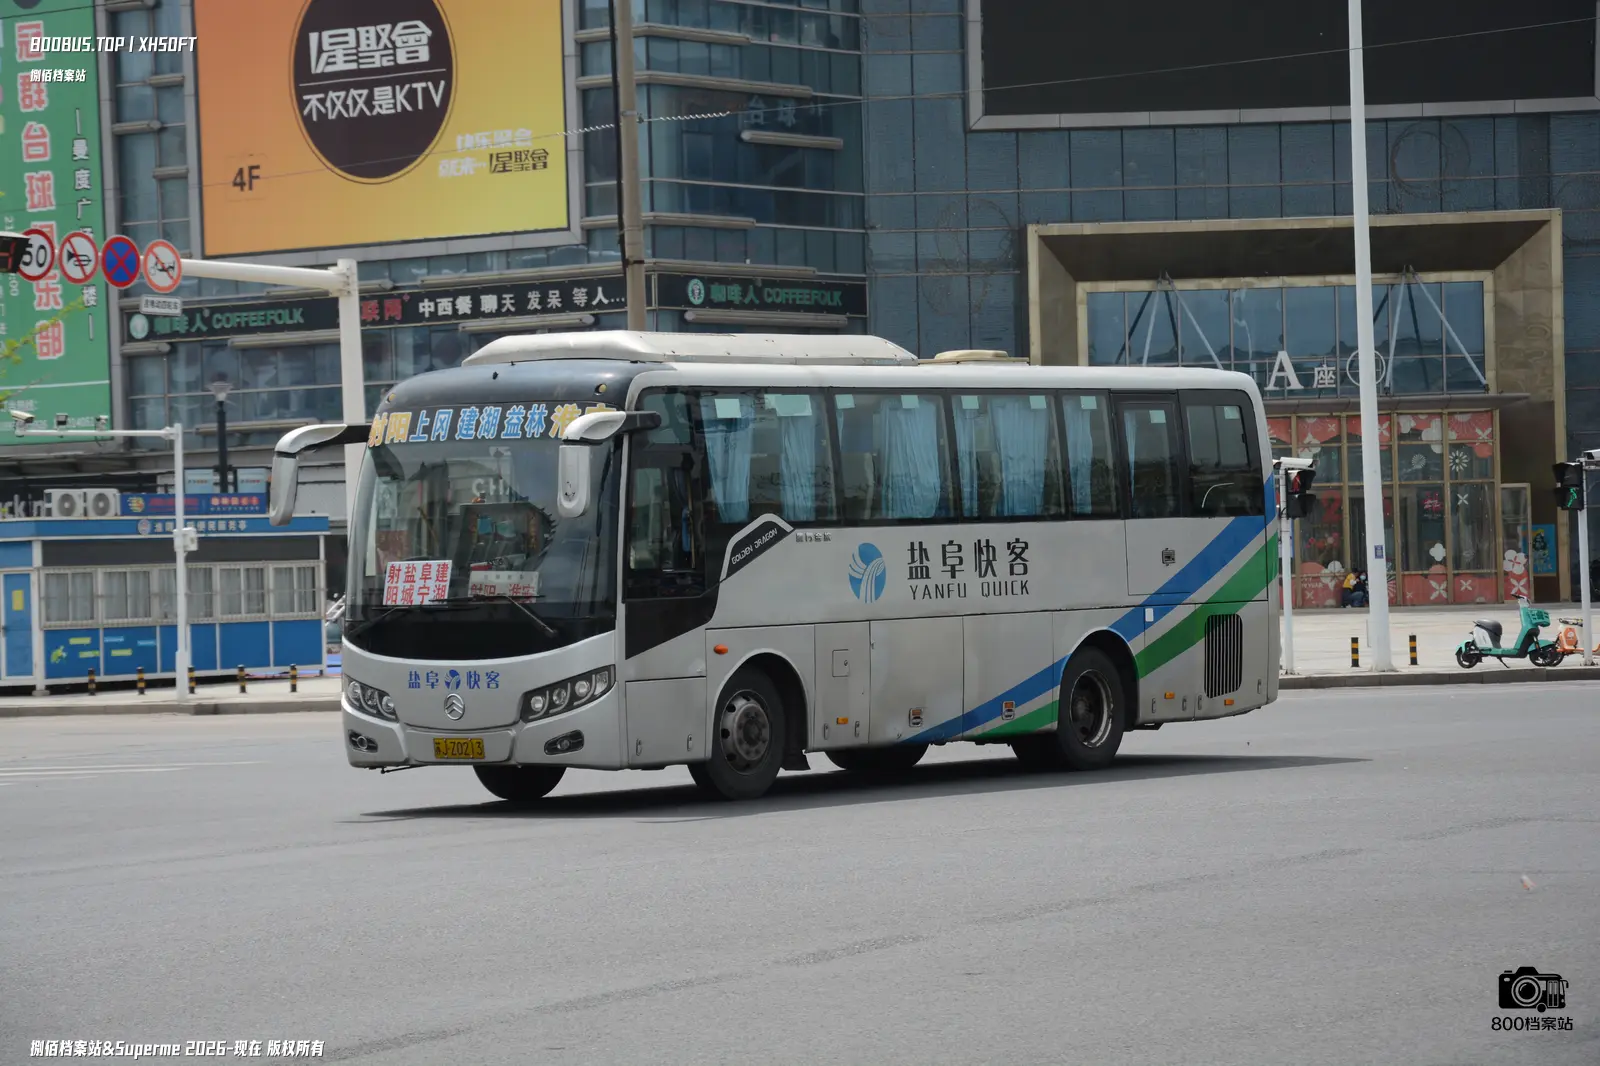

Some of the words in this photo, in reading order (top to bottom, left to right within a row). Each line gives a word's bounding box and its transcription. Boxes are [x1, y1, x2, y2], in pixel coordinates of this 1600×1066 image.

[303, 80, 446, 122] 不仅仅是KTV
[232, 165, 261, 192] 4F
[764, 287, 843, 306] COFFEEFOLK
[212, 308, 304, 329] COFFEEFOLK
[731, 545, 754, 565] GOLDEN
[754, 528, 778, 549] DRAGON
[907, 537, 1030, 580] 盐阜快客
[910, 583, 967, 600] YANFU
[981, 579, 1030, 598] QUICK
